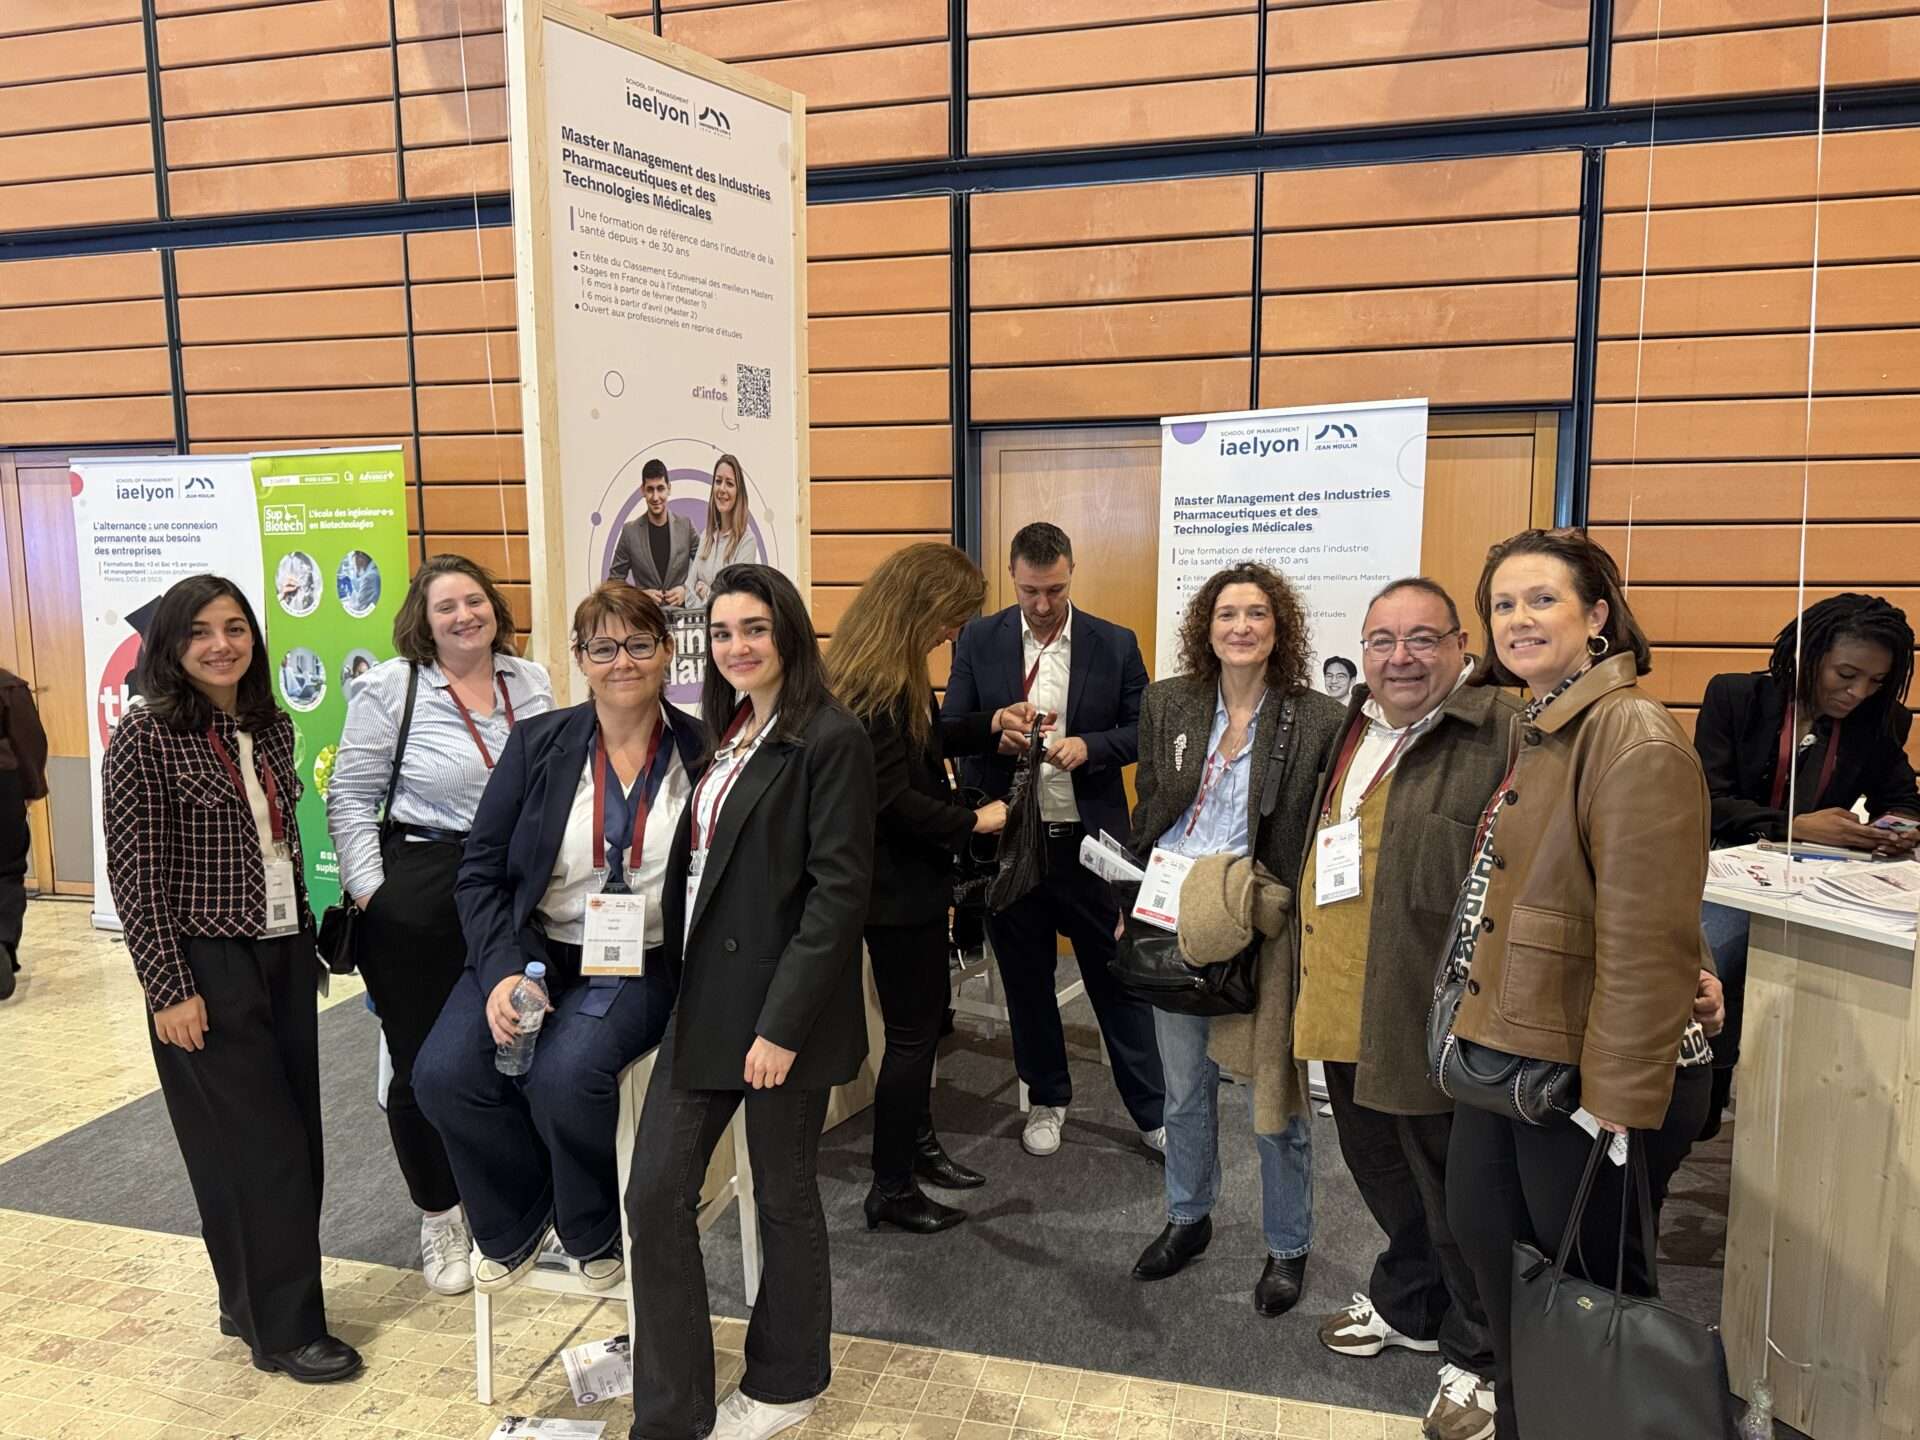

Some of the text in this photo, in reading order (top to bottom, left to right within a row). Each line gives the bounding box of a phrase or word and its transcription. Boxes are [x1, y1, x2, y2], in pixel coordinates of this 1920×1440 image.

[626, 77, 646, 90] SCHOOL
[656, 88, 688, 104] MANAGEMENT
[626, 86, 689, 126] iaelyon
[562, 126, 771, 200] Master Management des Industries
[562, 148, 716, 202] Pharmaceutiques et des
[562, 170, 712, 220] Technologies Médicales
[578, 208, 774, 265] Une formation de référence dans l'industrie de la
[580, 224, 606, 238] santé
[608, 231, 638, 246] depuis
[648, 240, 660, 250] de
[662, 242, 674, 253] 30
[676, 247, 690, 257] ans
[580, 250, 774, 301] En tête du Classement Eduniversal des meilleurs Masters
[580, 264, 608, 278] Stages
[609, 272, 620, 280] en
[621, 272, 648, 286] France
[649, 280, 659, 288] ou
[660, 280, 666, 289] à
[666, 282, 713, 298] l'international
[586, 278, 592, 286] 6
[594, 280, 612, 290] mois
[614, 283, 619, 291] à
[620, 286, 640, 296] partir
[642, 289, 650, 298] de
[652, 290, 674, 302] février
[676, 296, 700, 307] (Master
[587, 291, 698, 320] 6 mois à partir d'avril (Master 2)
[582, 302, 609, 316] Ouvert
[611, 309, 625, 318] aux
[627, 312, 680, 328] professionnels
[691, 324, 714, 336] reprise
[716, 328, 742, 340] d'études
[692, 386, 728, 400] d'infos
[1256, 426, 1300, 434] MANAGEMENT
[1220, 437, 1299, 458] iaelyon
[116, 484, 174, 502] iaelyon
[1174, 488, 1390, 506] Master Management des Industries
[265, 508, 282, 520] Sup
[308, 509, 333, 518] L'école
[334, 508, 346, 517] des
[1174, 506, 1318, 521] Pharmaceutiques et des
[94, 521, 147, 530] L'alternance
[170, 520, 218, 530] connexion
[265, 520, 304, 532] Biotech
[308, 520, 374, 530] en Biotechnologies
[1174, 521, 1312, 536] Technologies Médicales
[94, 535, 147, 544] permanente
[166, 534, 200, 542] besoins
[94, 546, 162, 556] des entreprises
[1178, 544, 1369, 556] Une formation de référence dans l'industrie
[1178, 558, 1190, 566] de
[1191, 557, 1198, 566] la
[1200, 556, 1224, 566] santé
[1266, 556, 1277, 565] de
[1279, 556, 1290, 564] 30
[1312, 610, 1346, 618] d'études
